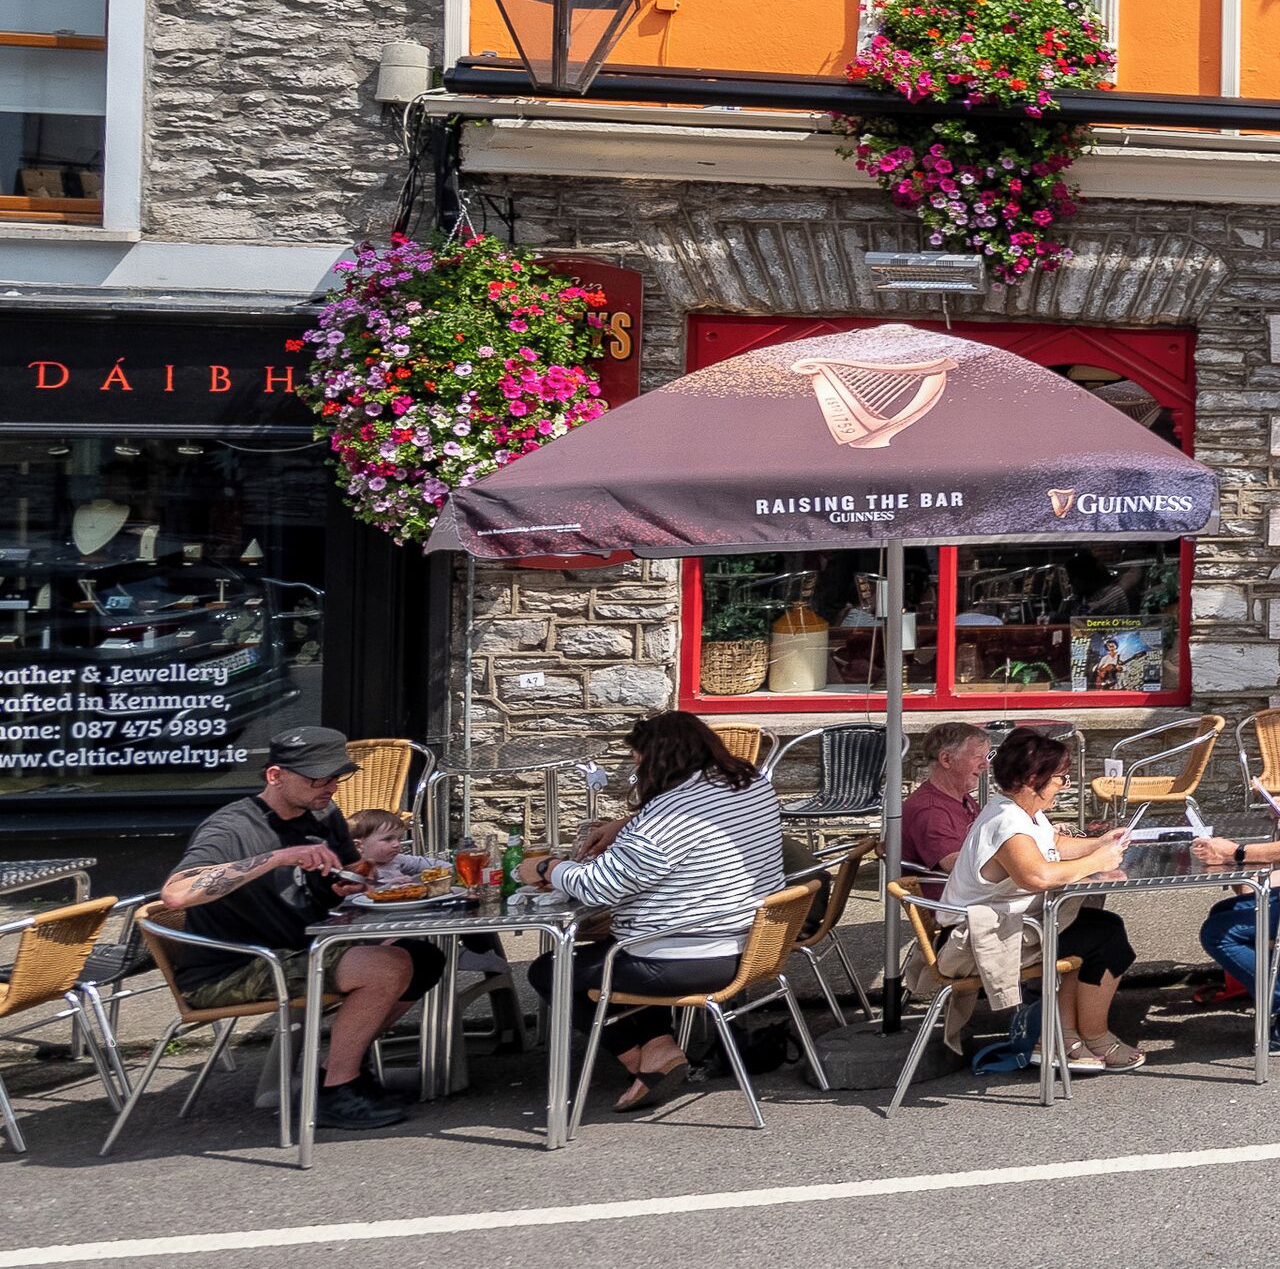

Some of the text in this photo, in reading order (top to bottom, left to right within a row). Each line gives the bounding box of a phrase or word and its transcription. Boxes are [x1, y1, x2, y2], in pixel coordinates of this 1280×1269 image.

[755, 491, 964, 515] RAISING THE BAR
[1076, 493, 1193, 514] GUINNESS
[829, 510, 895, 523] GUINNESS
[81, 665, 101, 683] &
[106, 664, 229, 686] Jewellery
[77, 692, 105, 711] in
[109, 692, 232, 712] Kenmare,
[72, 720, 117, 740] 087
[121, 718, 163, 738] 475
[168, 718, 228, 738] 9893
